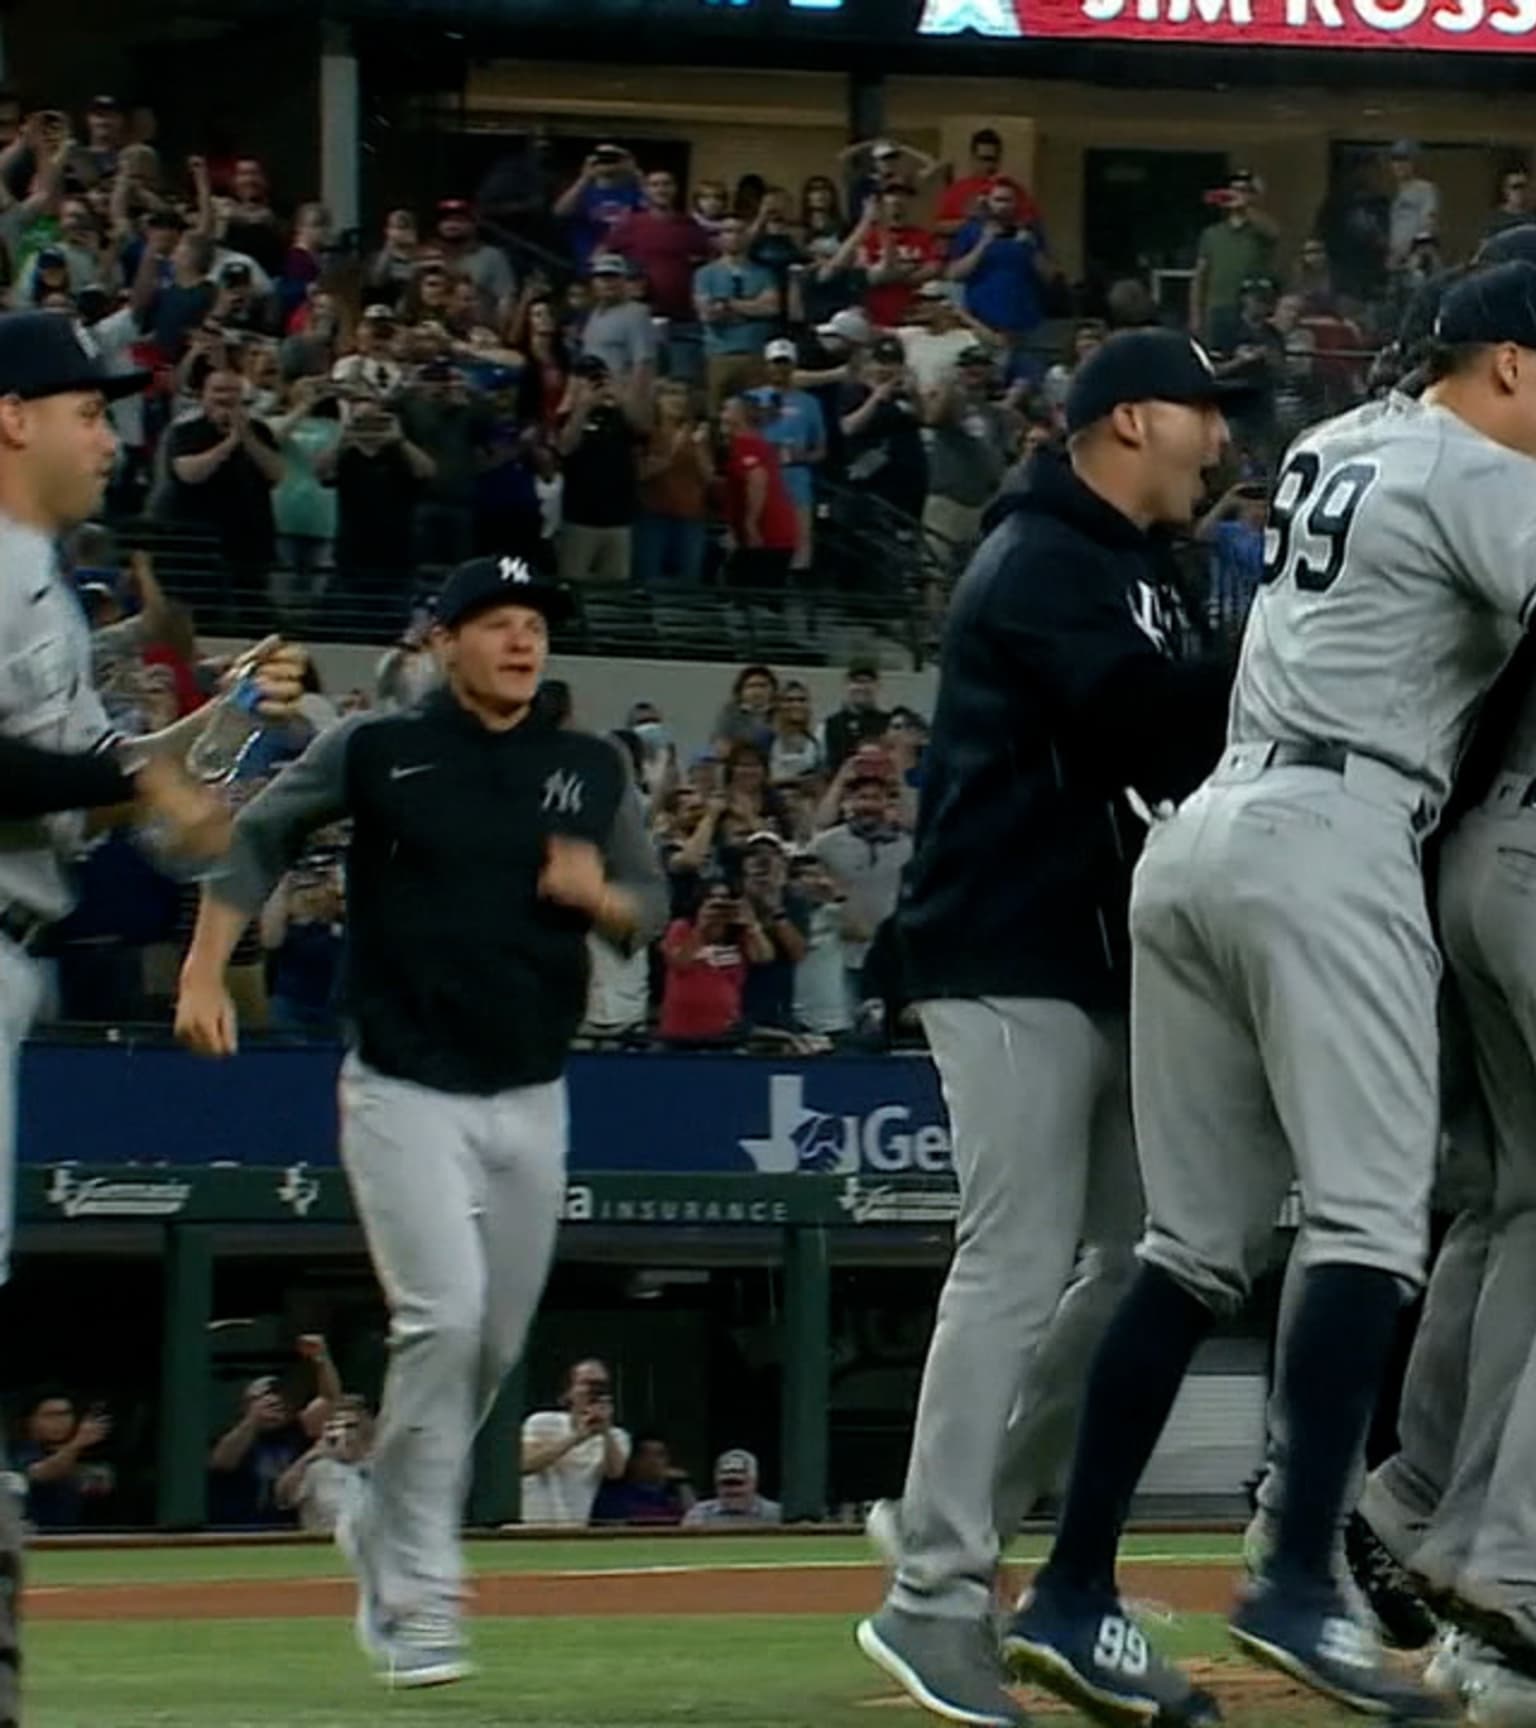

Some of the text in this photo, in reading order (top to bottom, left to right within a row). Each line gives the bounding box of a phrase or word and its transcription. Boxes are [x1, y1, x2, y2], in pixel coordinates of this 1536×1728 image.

[1263, 449, 1381, 593] 99
[601, 1200, 789, 1222] INSURANCE
[1093, 1614, 1149, 1677] 99
